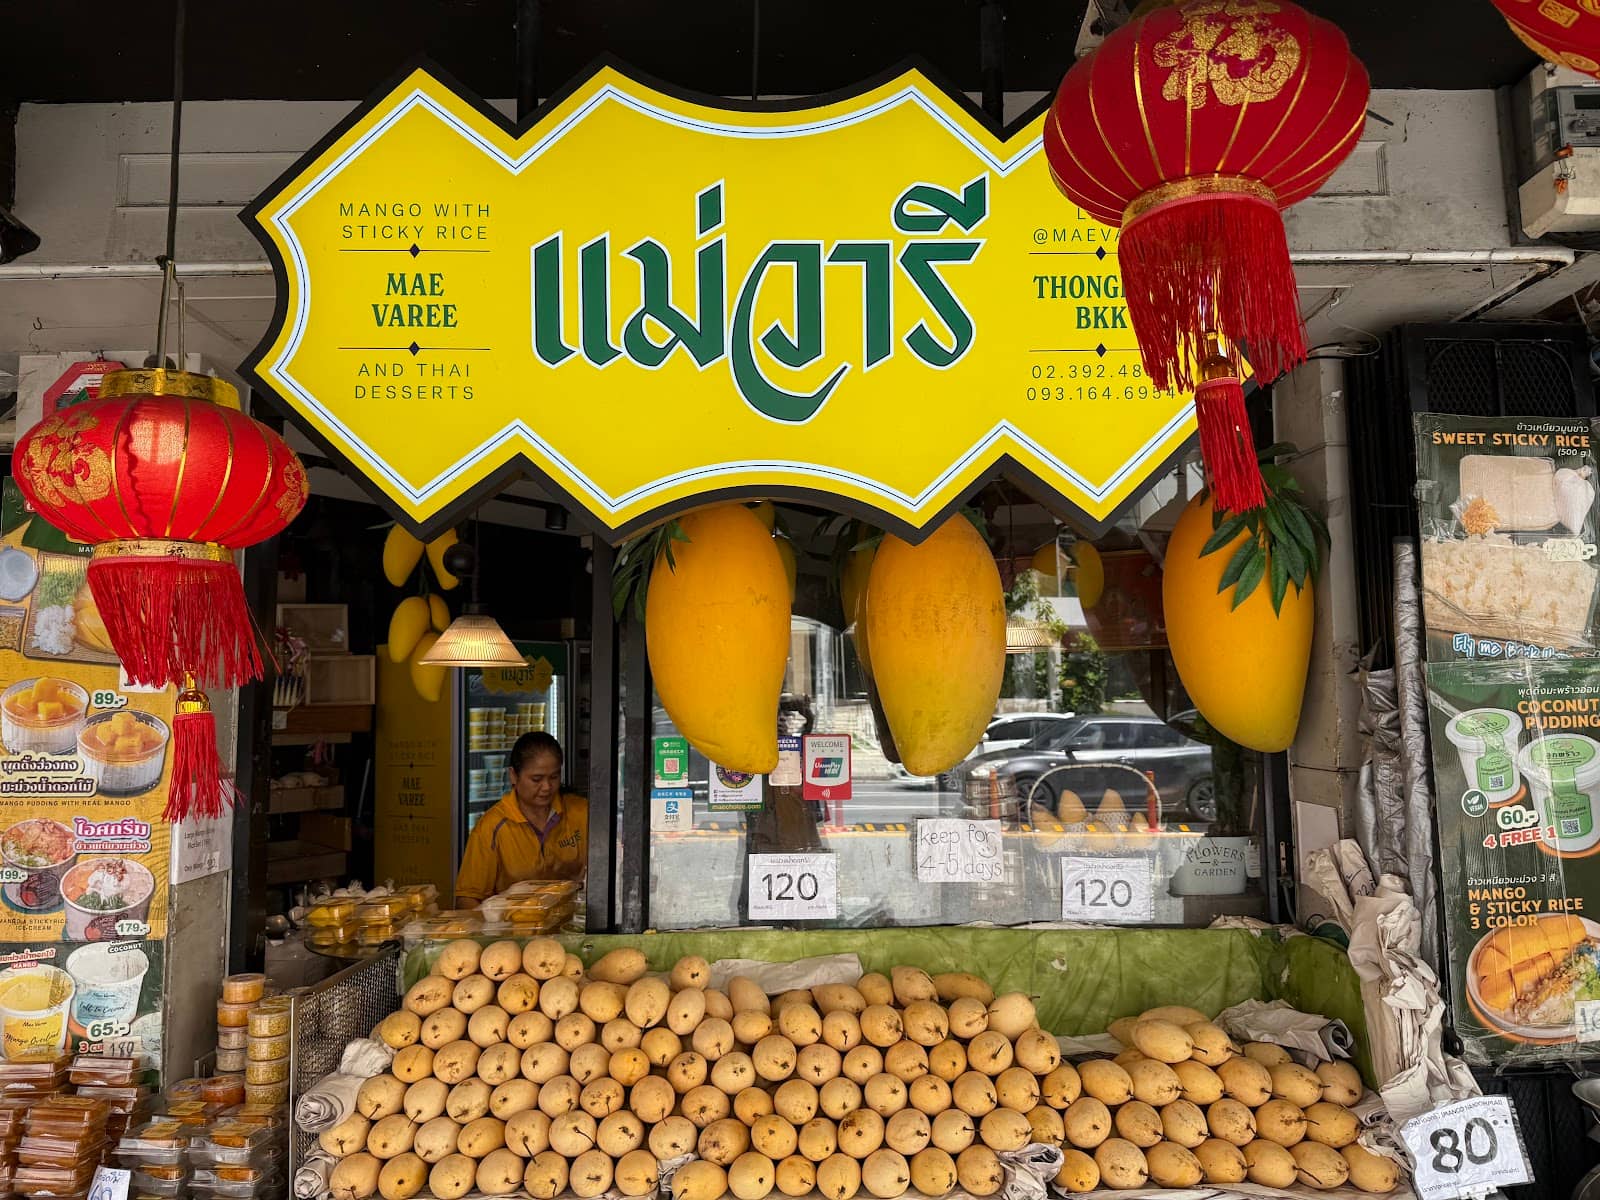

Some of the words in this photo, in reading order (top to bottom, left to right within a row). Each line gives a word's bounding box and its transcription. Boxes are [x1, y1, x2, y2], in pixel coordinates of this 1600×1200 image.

[339, 202, 422, 217] MANGO
[434, 203, 490, 218] WITH
[342, 225, 424, 240] STICKY
[437, 226, 488, 240] RICE
[385, 273, 445, 297] MAE
[1033, 275, 1126, 299] THONG
[532, 172, 988, 424] แม่วารี
[372, 303, 459, 328] VAREE
[1075, 306, 1128, 329] BKK
[358, 363, 404, 377] AND
[416, 363, 471, 378] THAI
[355, 385, 474, 400] DESSERTS
[1433, 432, 1486, 445] SWEET
[1493, 432, 1549, 447] STICKY
[1556, 435, 1591, 448] RICE
[1557, 447, 1578, 457] (500
[94, 692, 125, 706] 89.-
[1517, 698, 1600, 714] COCONUT
[1525, 714, 1600, 730] PUDDING
[1501, 809, 1535, 825] 60.-
[75, 818, 149, 838] ไอศกรีม
[919, 824, 960, 850] keep
[1484, 835, 1496, 848] 4
[1501, 829, 1542, 847] FREE
[1546, 827, 1557, 839] 1
[1185, 847, 1245, 864] FLOWERS
[919, 851, 960, 877] 4-5
[965, 853, 1002, 881] days
[1194, 867, 1237, 877] GARDEN
[762, 872, 819, 901] 120
[1075, 879, 1133, 908] 120
[1468, 887, 1526, 901] MANGO
[1469, 902, 1480, 915] &
[1487, 900, 1542, 914] STICKY
[1548, 898, 1584, 911] RICE
[118, 923, 147, 933] 179.-
[1471, 916, 1480, 930] 3
[1486, 914, 1538, 929] COLOR
[109, 942, 143, 954] COCONUT
[91, 1021, 126, 1037] 65.-
[79, 1042, 88, 1052] 3
[1429, 1117, 1499, 1175] 80
